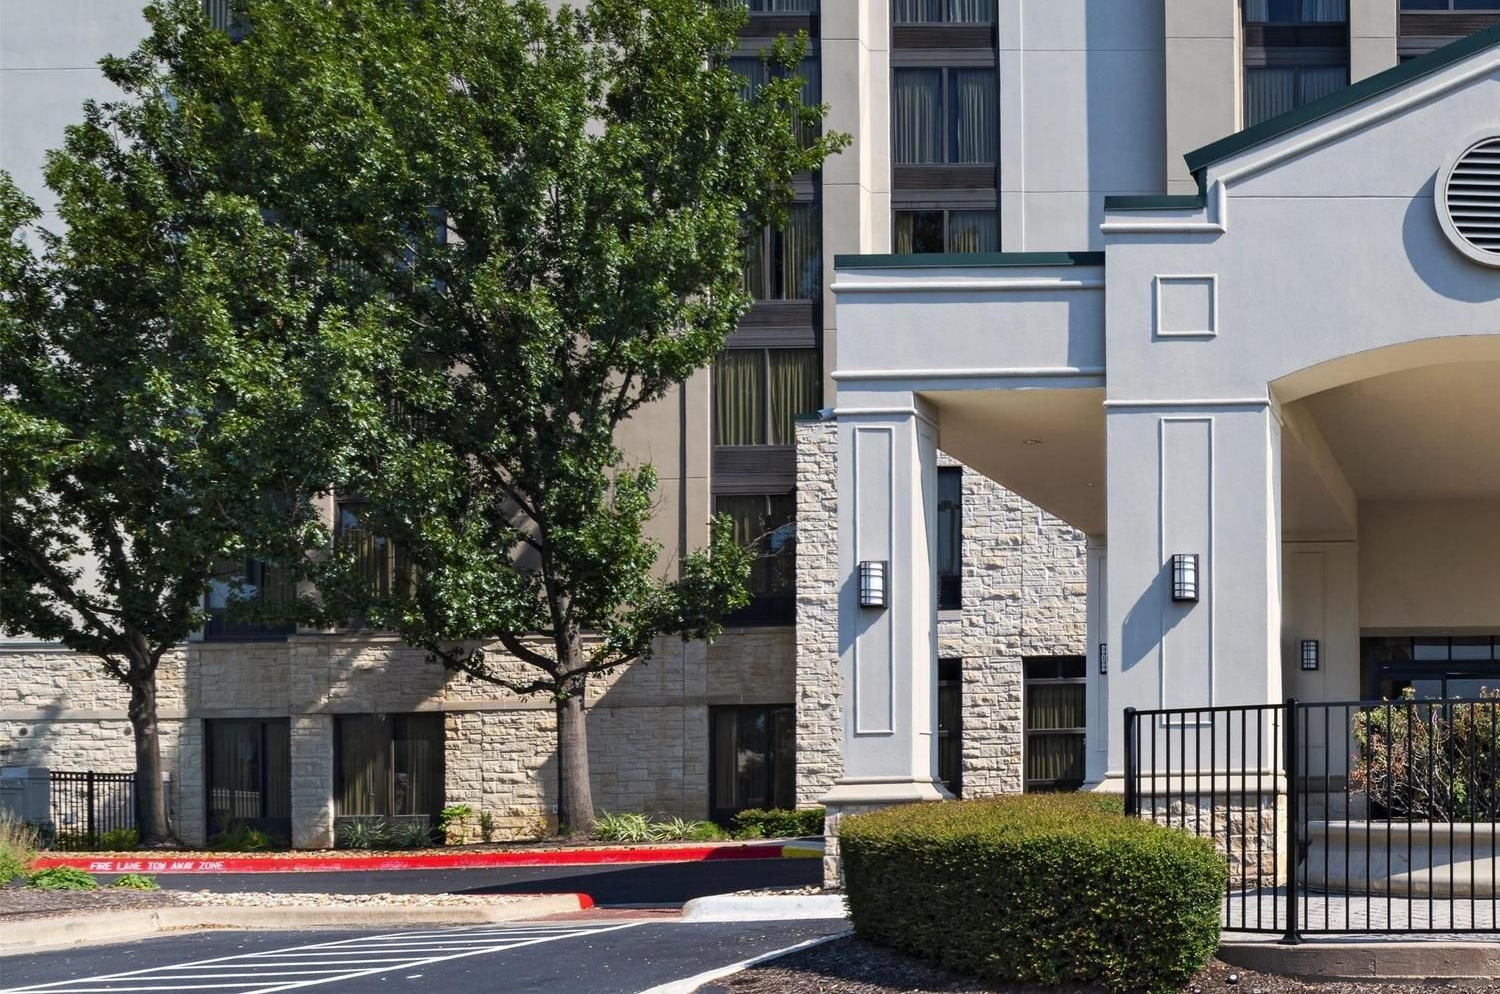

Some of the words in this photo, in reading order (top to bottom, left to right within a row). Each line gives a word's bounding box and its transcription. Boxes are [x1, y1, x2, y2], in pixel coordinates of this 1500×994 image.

[90, 861, 113, 871] FIRE
[116, 861, 143, 871] LANE
[148, 861, 167, 871] TOW
[170, 861, 195, 871] AWAY
[199, 861, 225, 871] ZONE
